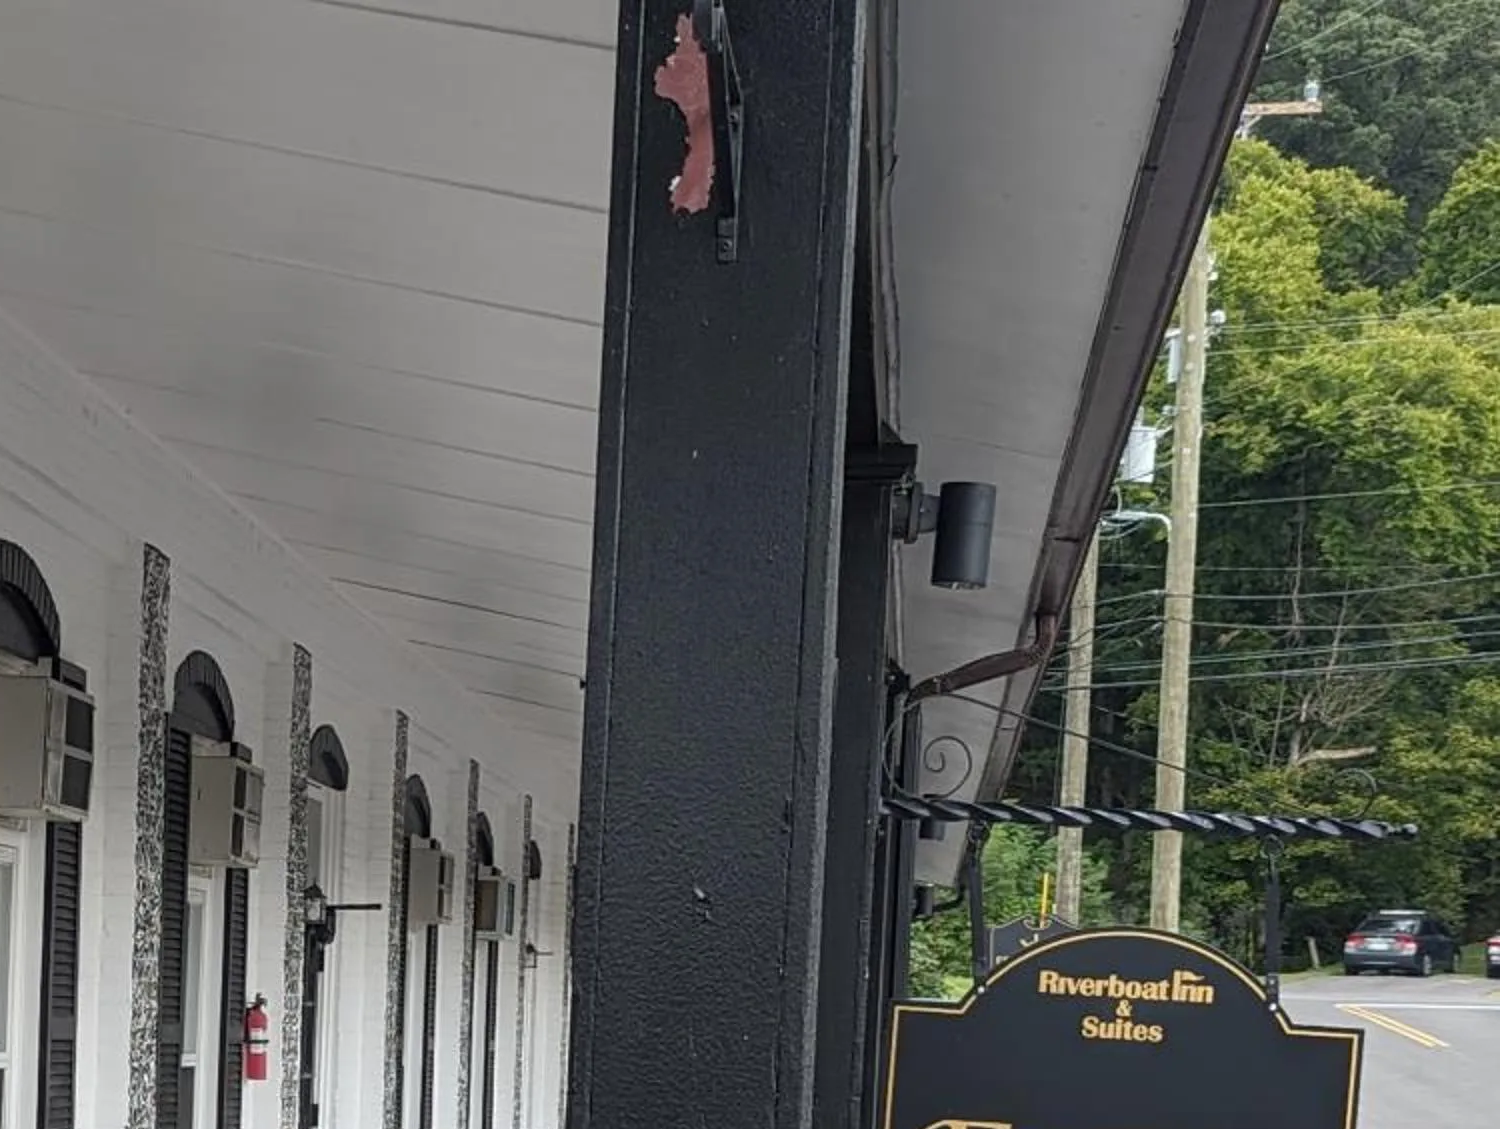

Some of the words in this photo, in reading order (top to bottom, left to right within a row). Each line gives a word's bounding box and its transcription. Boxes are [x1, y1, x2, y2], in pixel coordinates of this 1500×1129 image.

[1038, 969, 1170, 1001] Riverboat
[1171, 968, 1215, 1004] Inn
[1115, 999, 1133, 1017] &
[1081, 1015, 1163, 1043] Suites
